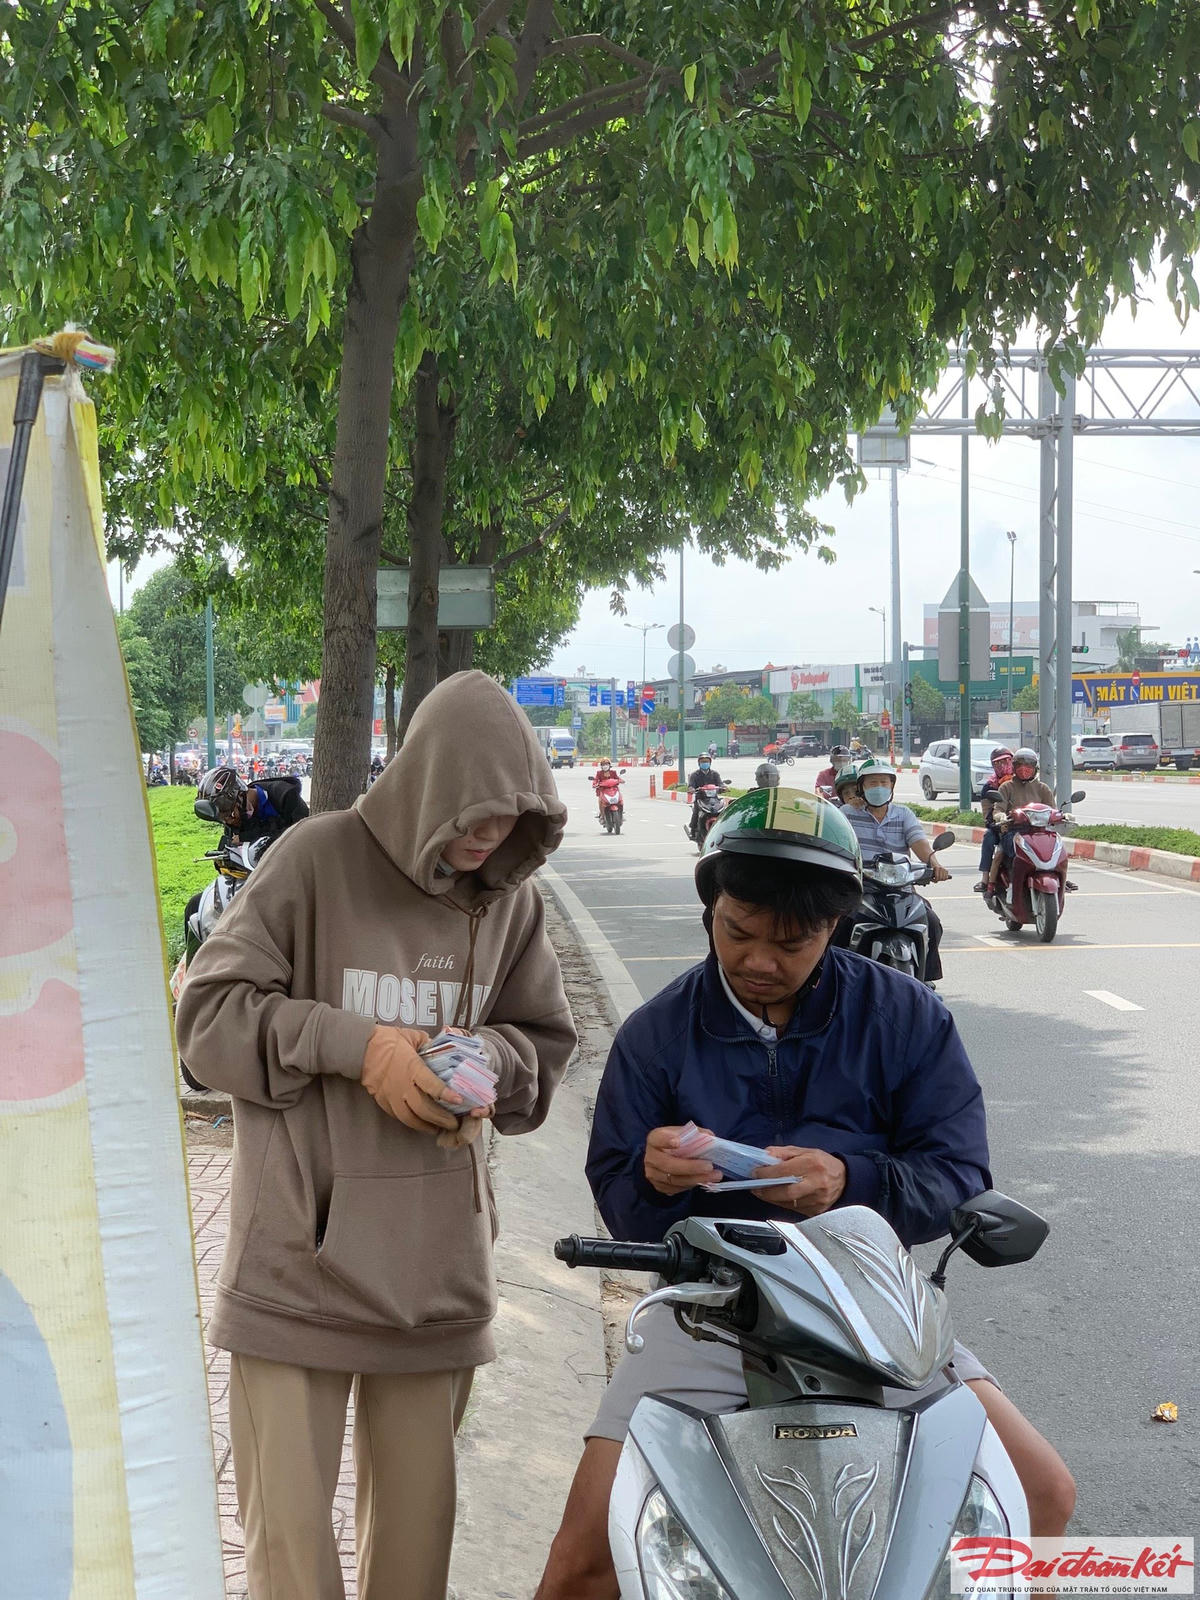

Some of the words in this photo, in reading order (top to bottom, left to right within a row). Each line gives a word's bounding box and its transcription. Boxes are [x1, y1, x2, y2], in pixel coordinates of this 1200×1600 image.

[1096, 680, 1126, 701] MẮT
[1130, 682, 1164, 701] ÍNH
[411, 953, 455, 973] faith
[777, 1426, 856, 1439] HONDA
